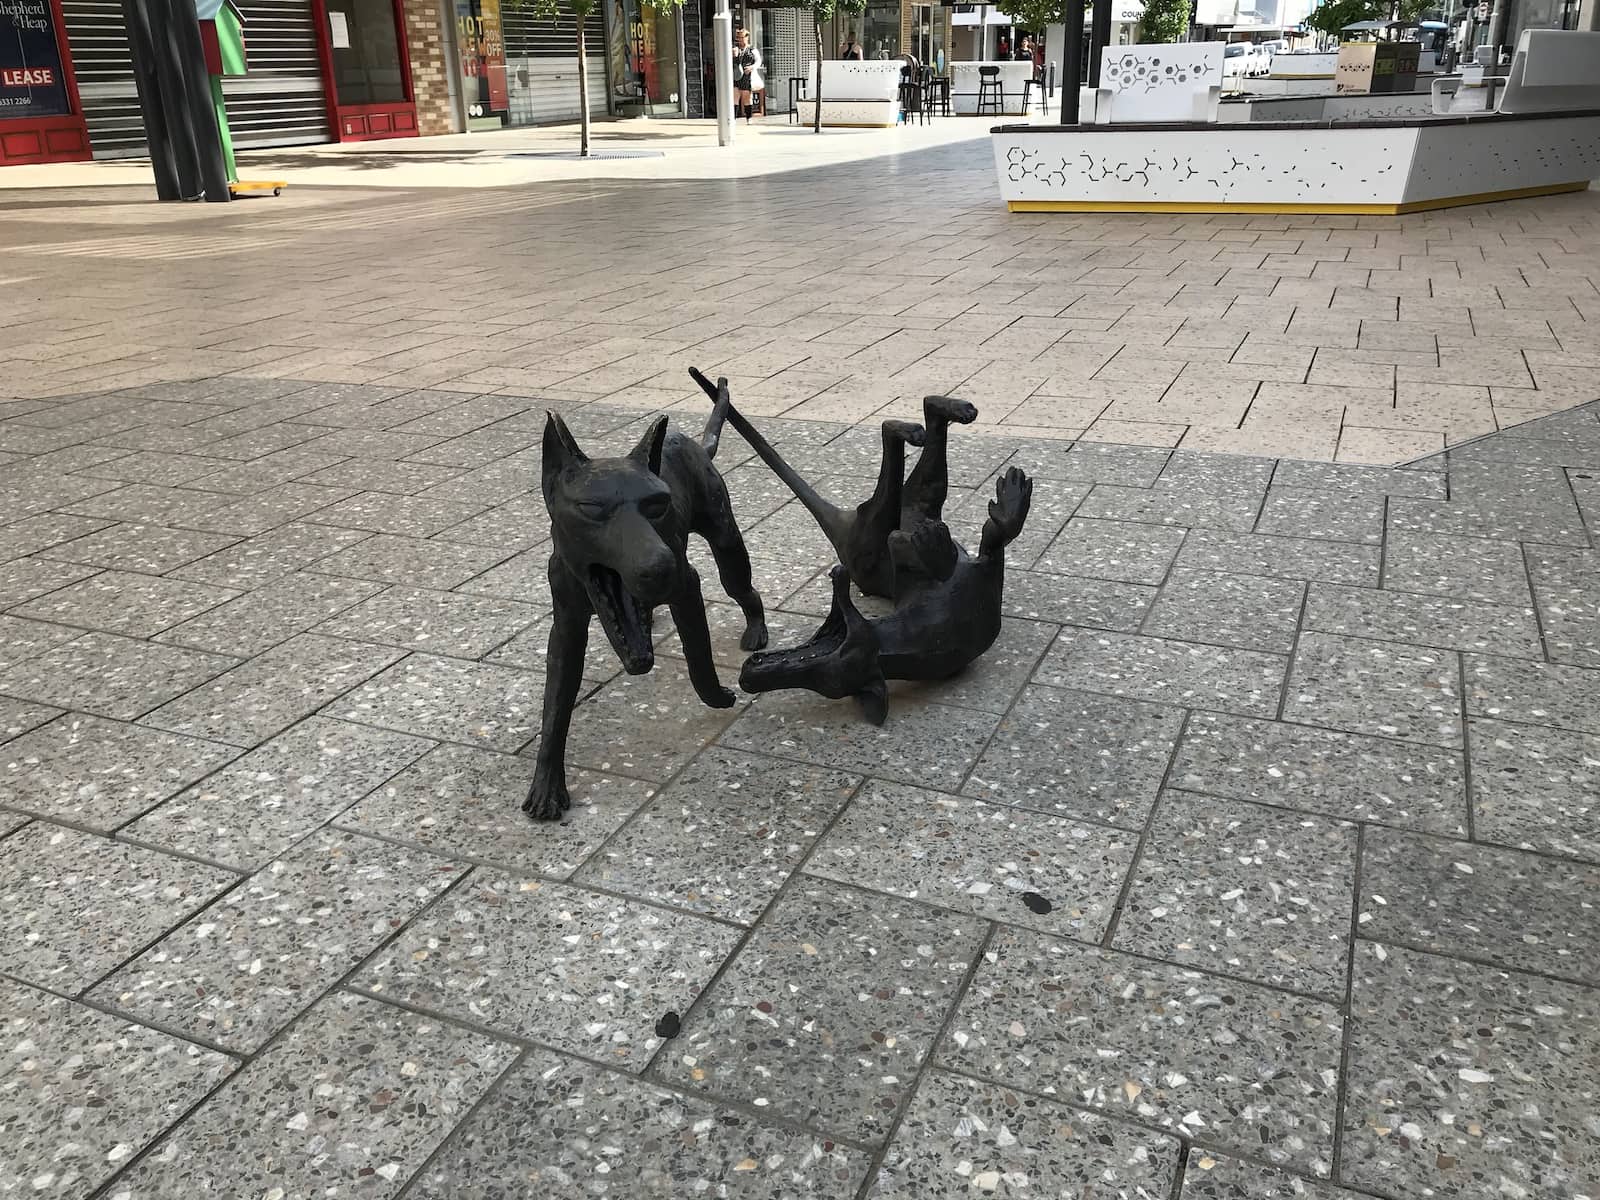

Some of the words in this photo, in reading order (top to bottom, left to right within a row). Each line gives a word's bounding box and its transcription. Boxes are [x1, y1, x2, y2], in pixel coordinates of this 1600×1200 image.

[0, 0, 45, 19] hepherd
[20, 15, 48, 32] Heap
[458, 15, 484, 35] HOT
[630, 22, 650, 39] HOT
[486, 43, 501, 57] OFF
[3, 70, 53, 85] LEASE
